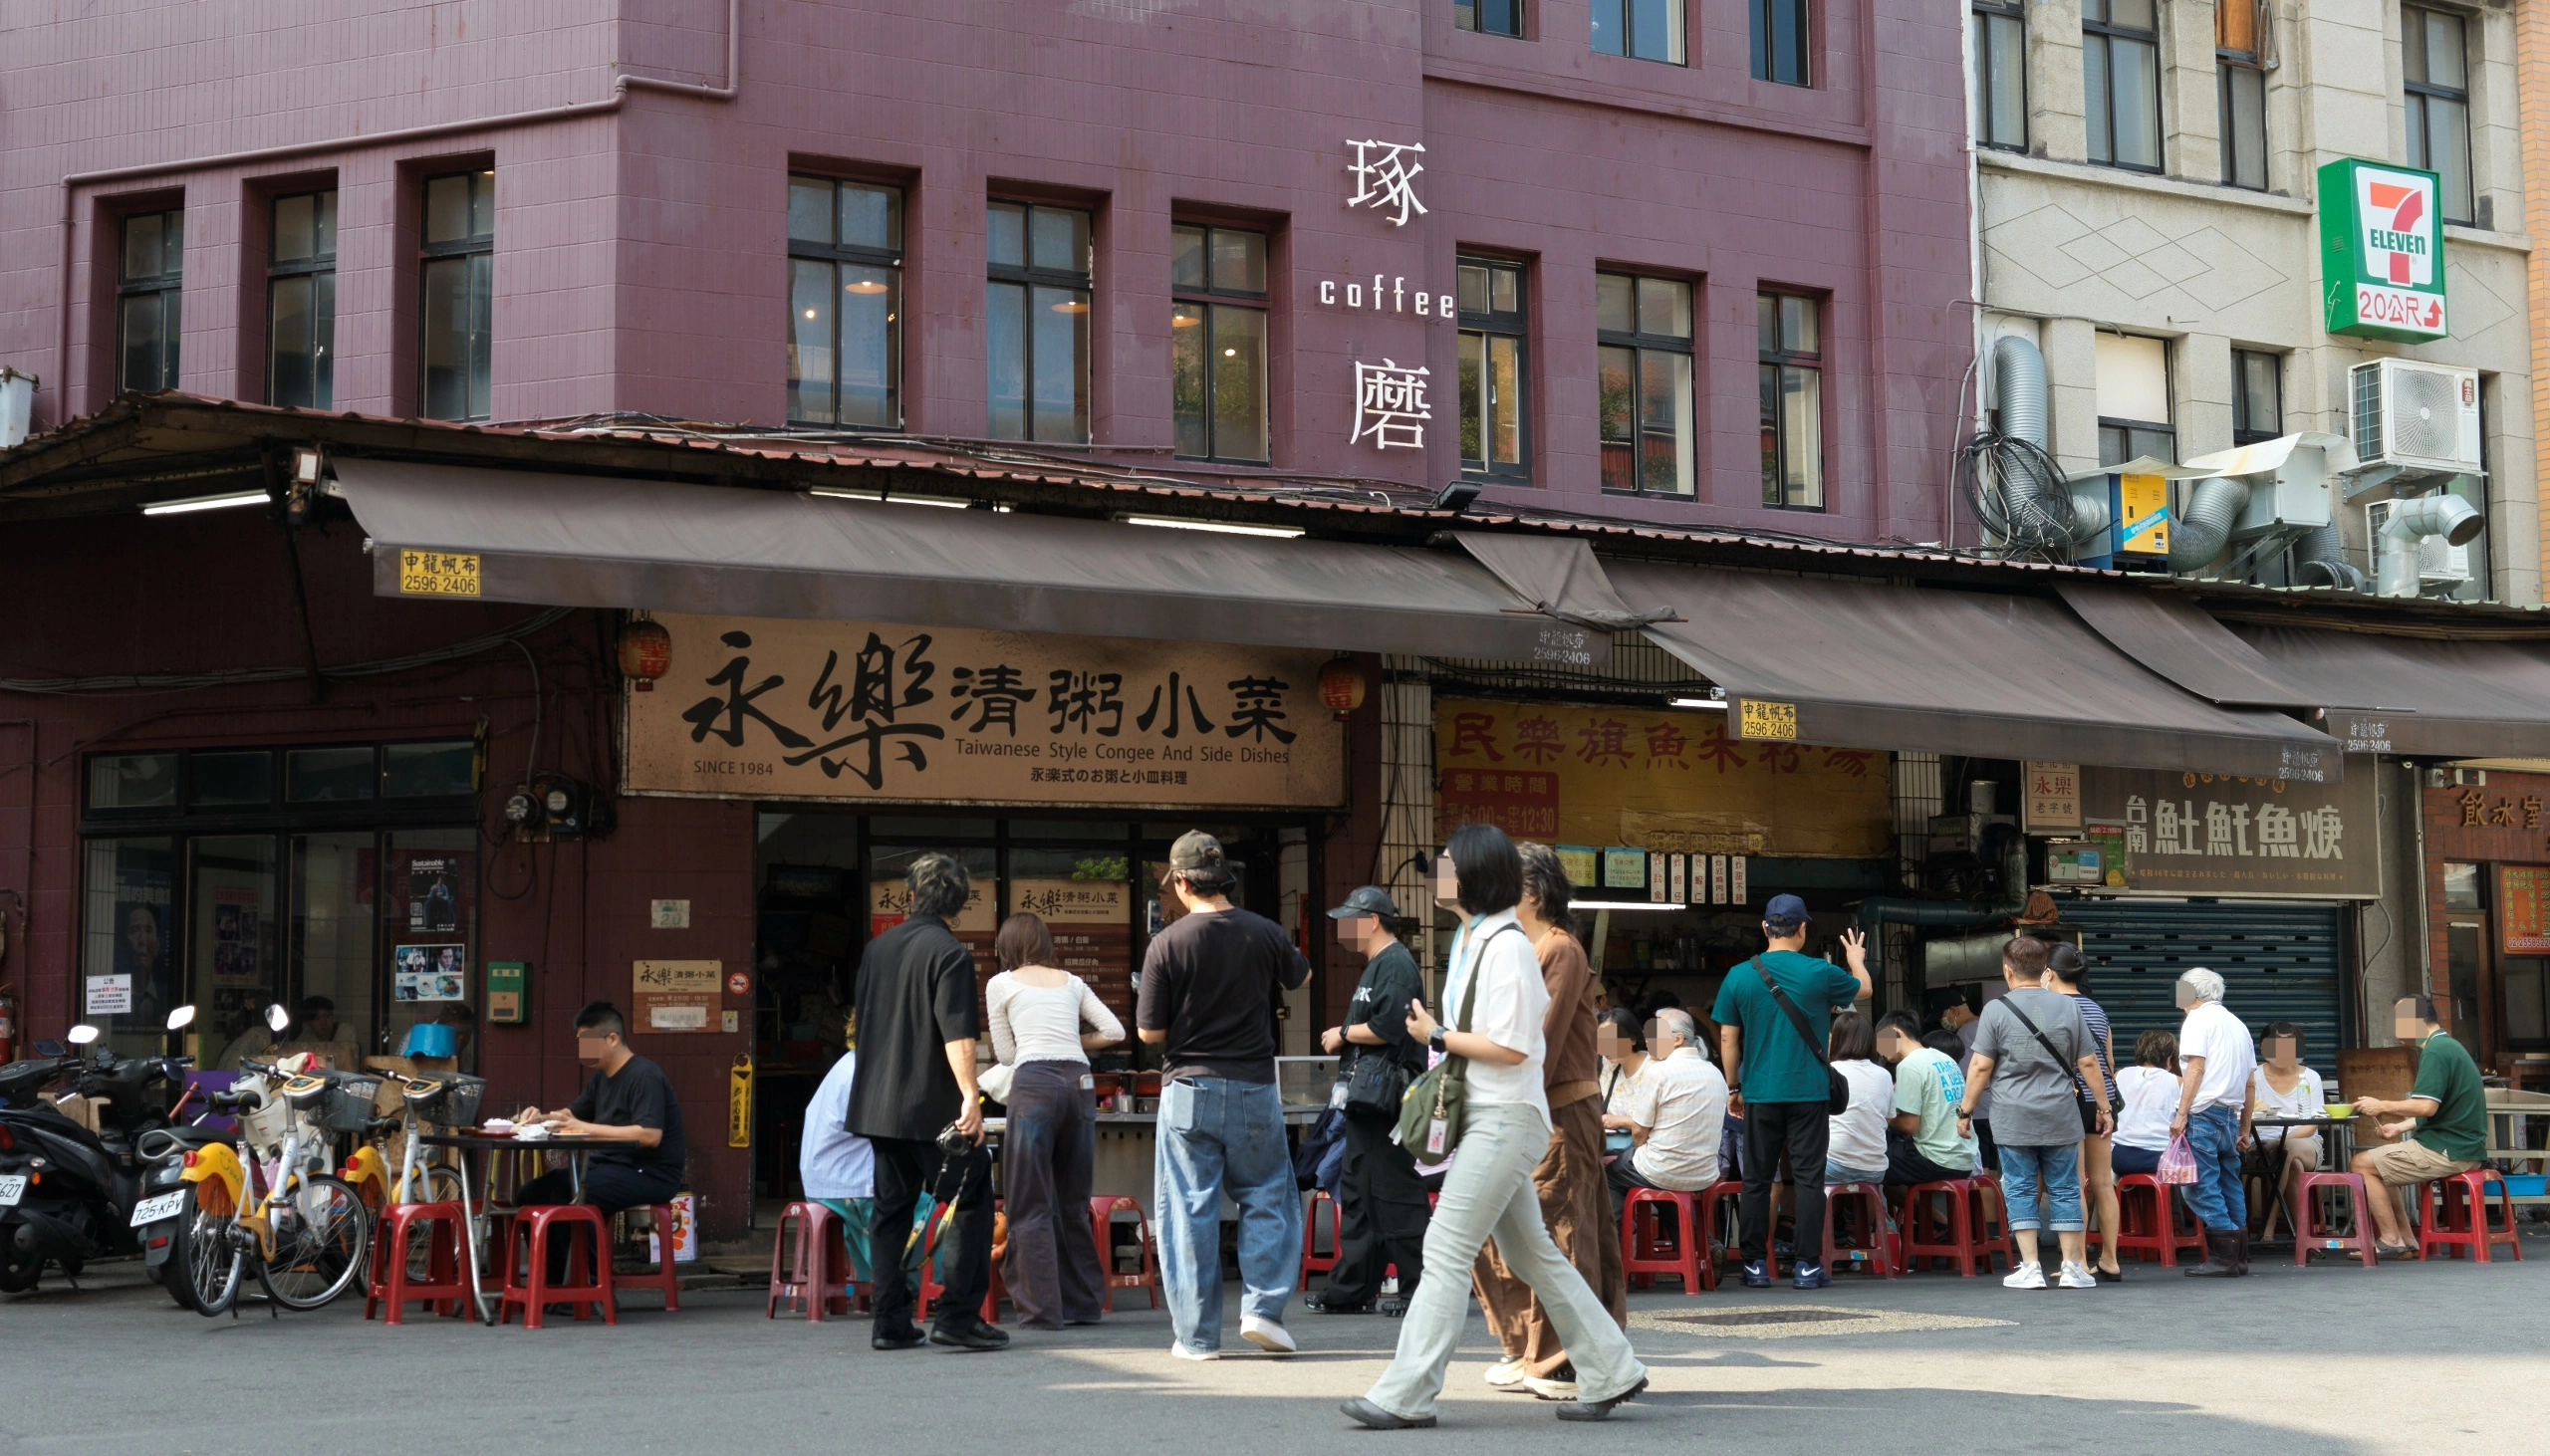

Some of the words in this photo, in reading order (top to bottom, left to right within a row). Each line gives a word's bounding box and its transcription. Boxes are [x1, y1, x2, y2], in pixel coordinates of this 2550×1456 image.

[1346, 138, 1428, 226] 琢
[1321, 274, 1453, 319] coffee
[2359, 290, 2422, 328] 20公尺
[1350, 358, 1432, 450] 磨
[404, 552, 477, 577] 申龍帆布
[1743, 701, 1794, 722] 申龍帆布
[955, 738, 1041, 758] Taiwanese
[1050, 741, 1088, 760] Style
[1096, 743, 1154, 764] Congee
[1162, 745, 1192, 761] And
[1200, 746, 1233, 762] Side
[1241, 747, 1290, 764] Dishes
[694, 760, 736, 775] SINCE
[739, 762, 774, 776] 1984
[1455, 774, 1548, 795] 營業時間
[2034, 777, 2073, 796] 永樂
[2035, 801, 2073, 815] 老字號
[2127, 795, 2148, 853] 台南
